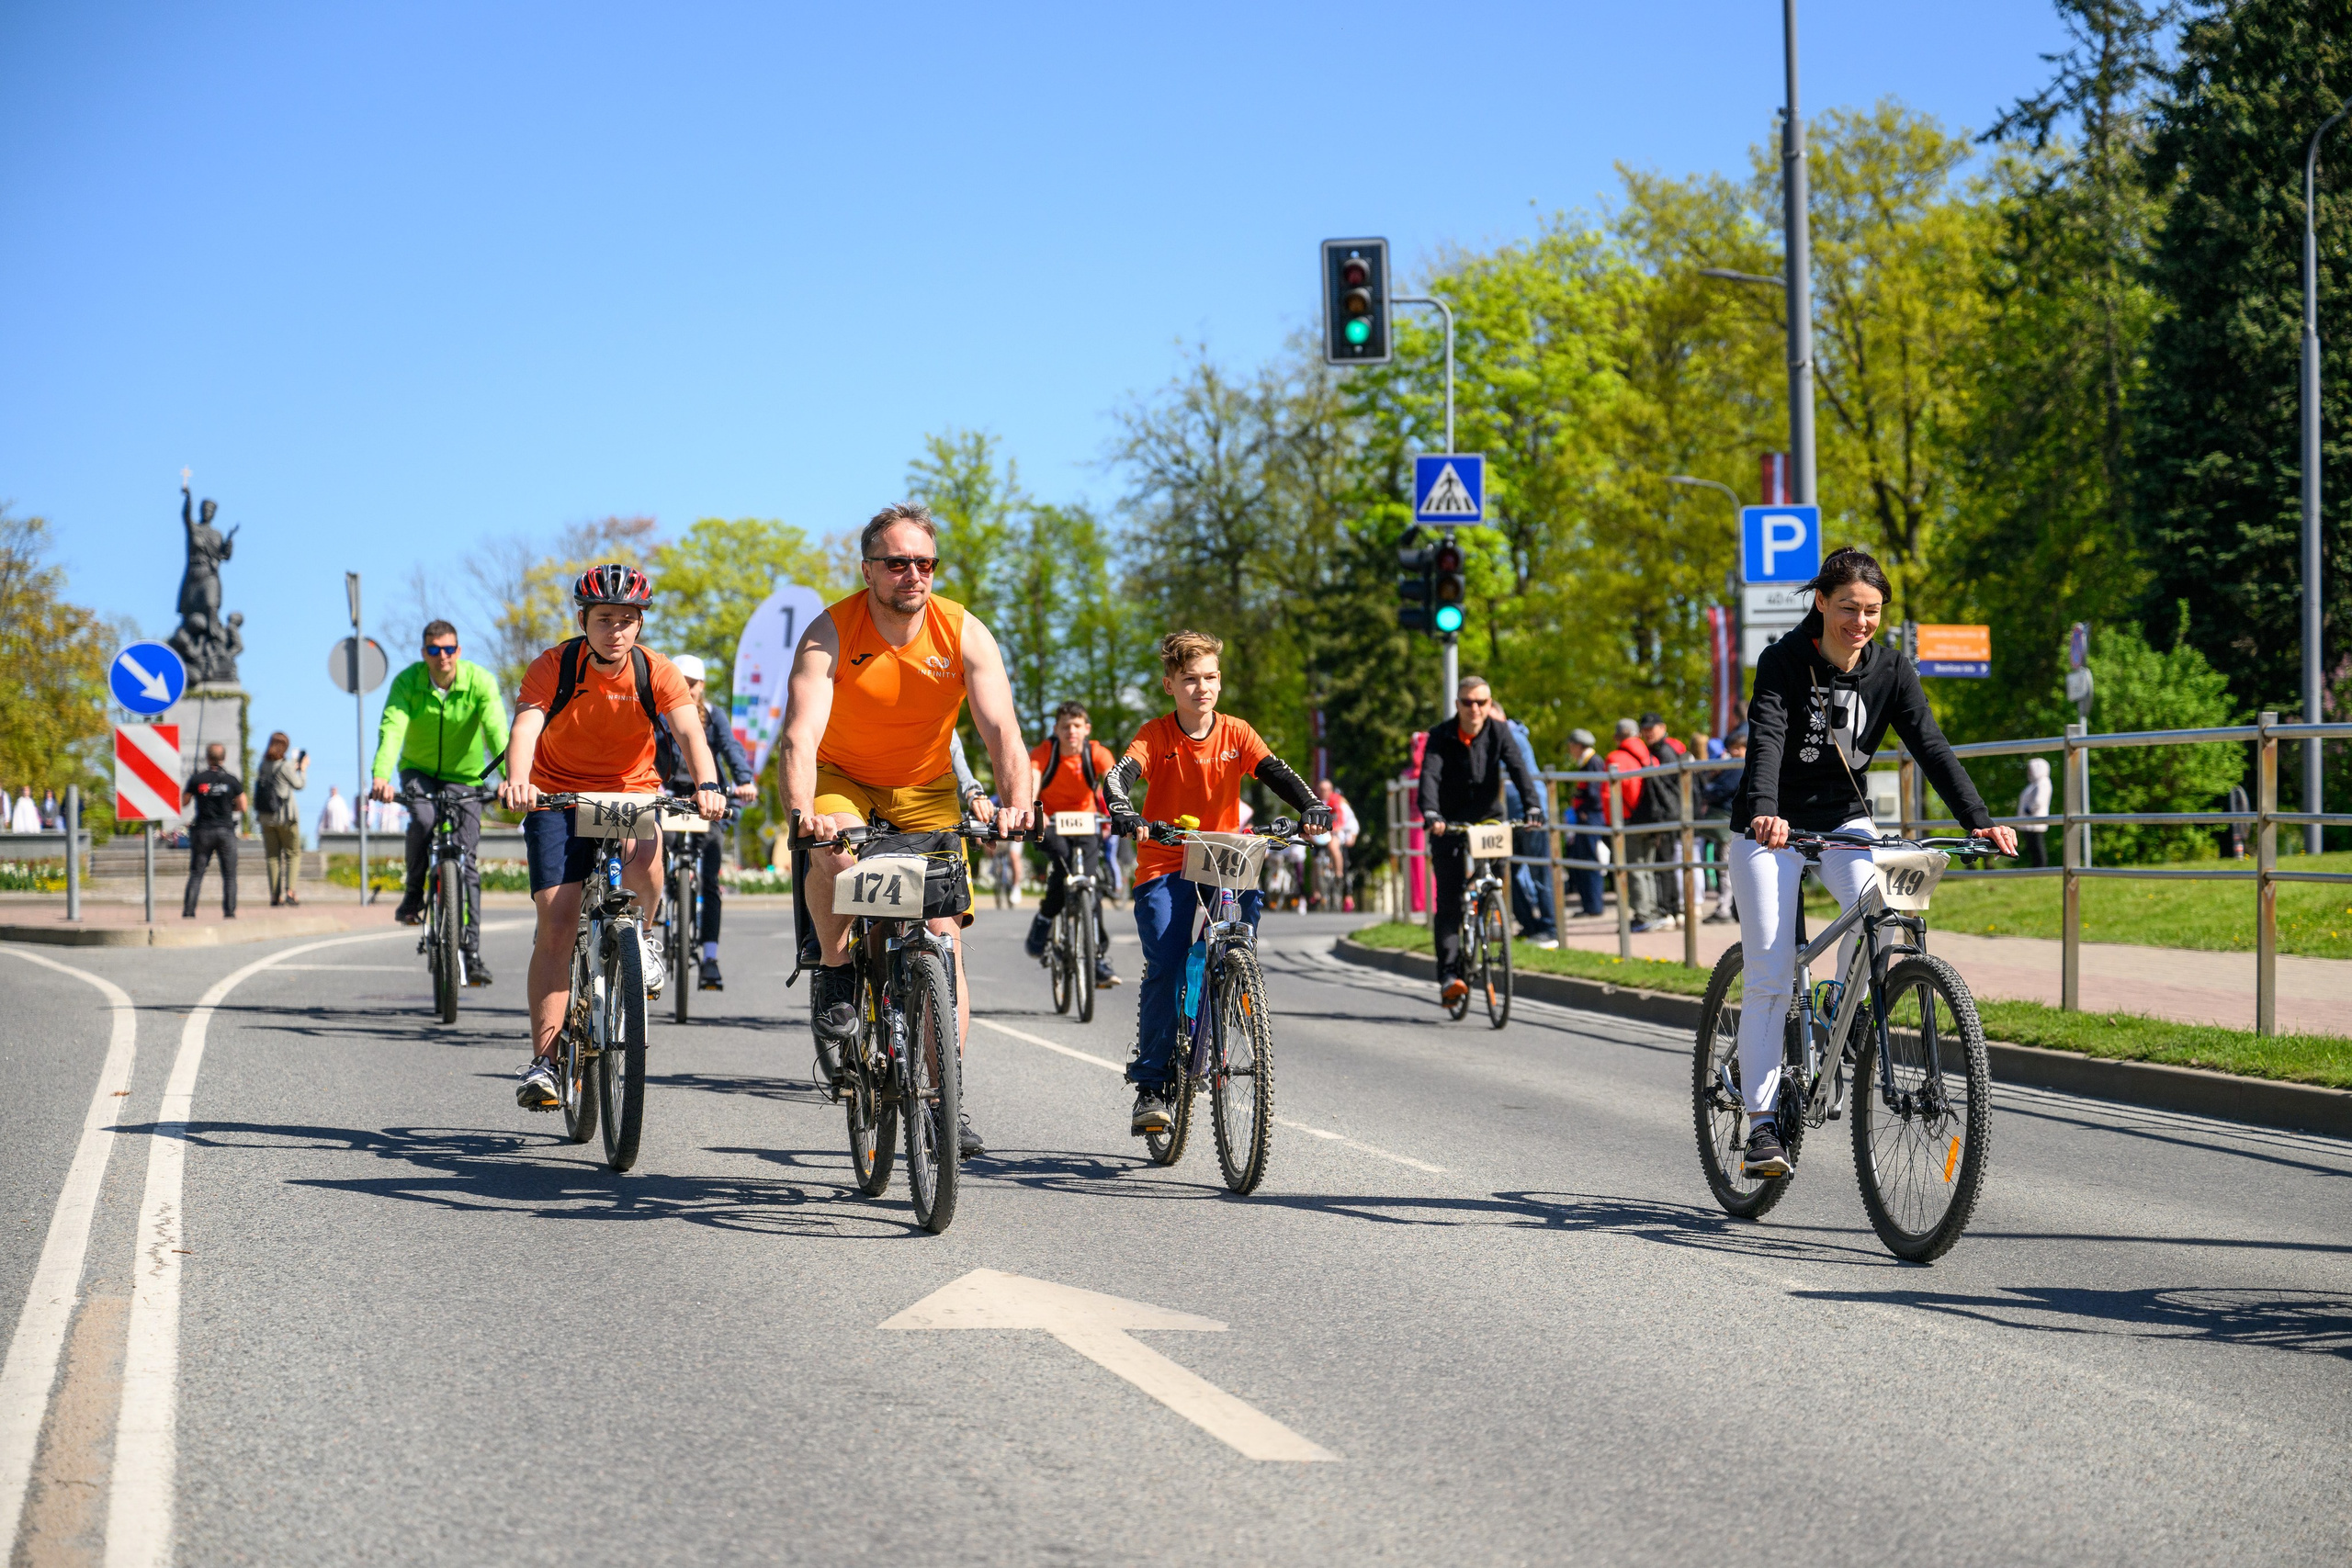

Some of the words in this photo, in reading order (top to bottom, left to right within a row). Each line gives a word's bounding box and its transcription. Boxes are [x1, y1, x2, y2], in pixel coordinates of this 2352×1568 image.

[1762, 514, 1807, 576] P
[779, 604, 795, 649] 1
[918, 668, 956, 679] INFINITY
[593, 799, 638, 828] 149
[1060, 818, 1083, 828] 166
[1481, 834, 1504, 850] 102
[1202, 845, 1247, 878] 149
[852, 872, 902, 906] 174
[1885, 866, 1926, 897] 149
[1860, 1012, 1874, 1053] SCHW
